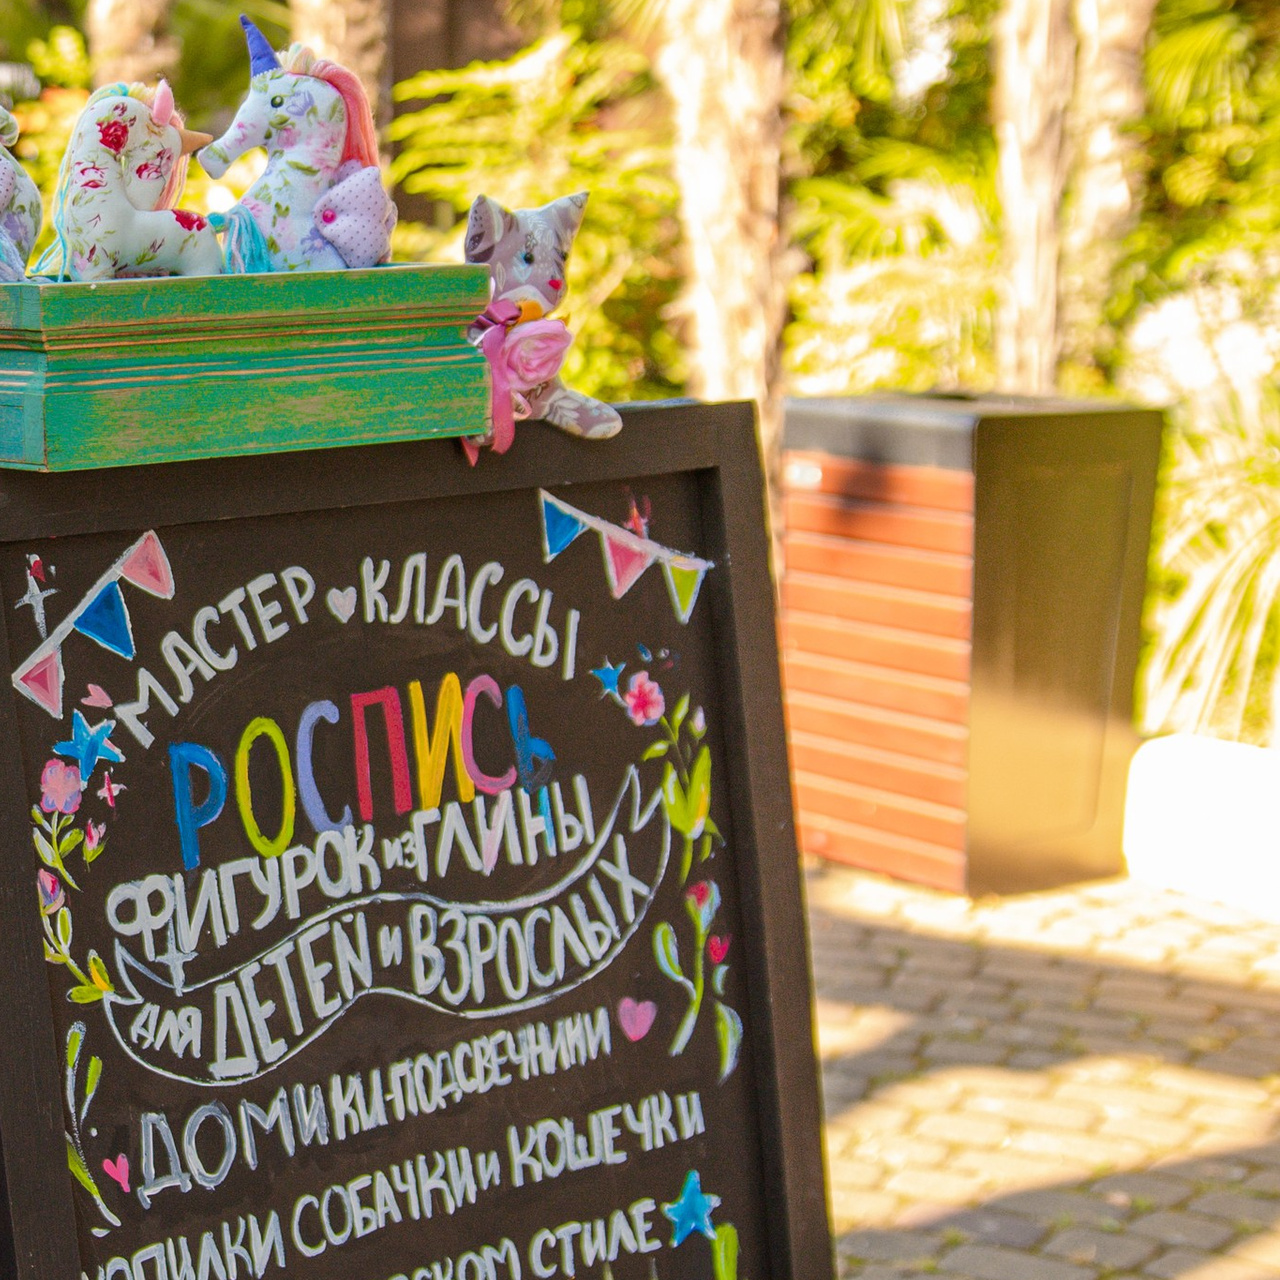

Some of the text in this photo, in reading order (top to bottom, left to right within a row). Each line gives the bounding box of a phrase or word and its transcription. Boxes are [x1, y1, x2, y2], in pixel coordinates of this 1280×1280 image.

[114, 551, 581, 749] МАСТЕР КЛАССЫ
[105, 823, 382, 961] ФИГУРОК
[410, 773, 596, 882] ГЛИНЫ
[167, 672, 557, 870] РОСПИСЬ
[208, 911, 373, 1079] ДЕТЕЙ
[408, 834, 651, 1006] ВЗРОСЛЫХ
[291, 1146, 478, 1257] СОБАЧКИ
[506, 1090, 706, 1187] КОШЕЧКИ
[528, 1197, 663, 1278] СТИЛЕ
